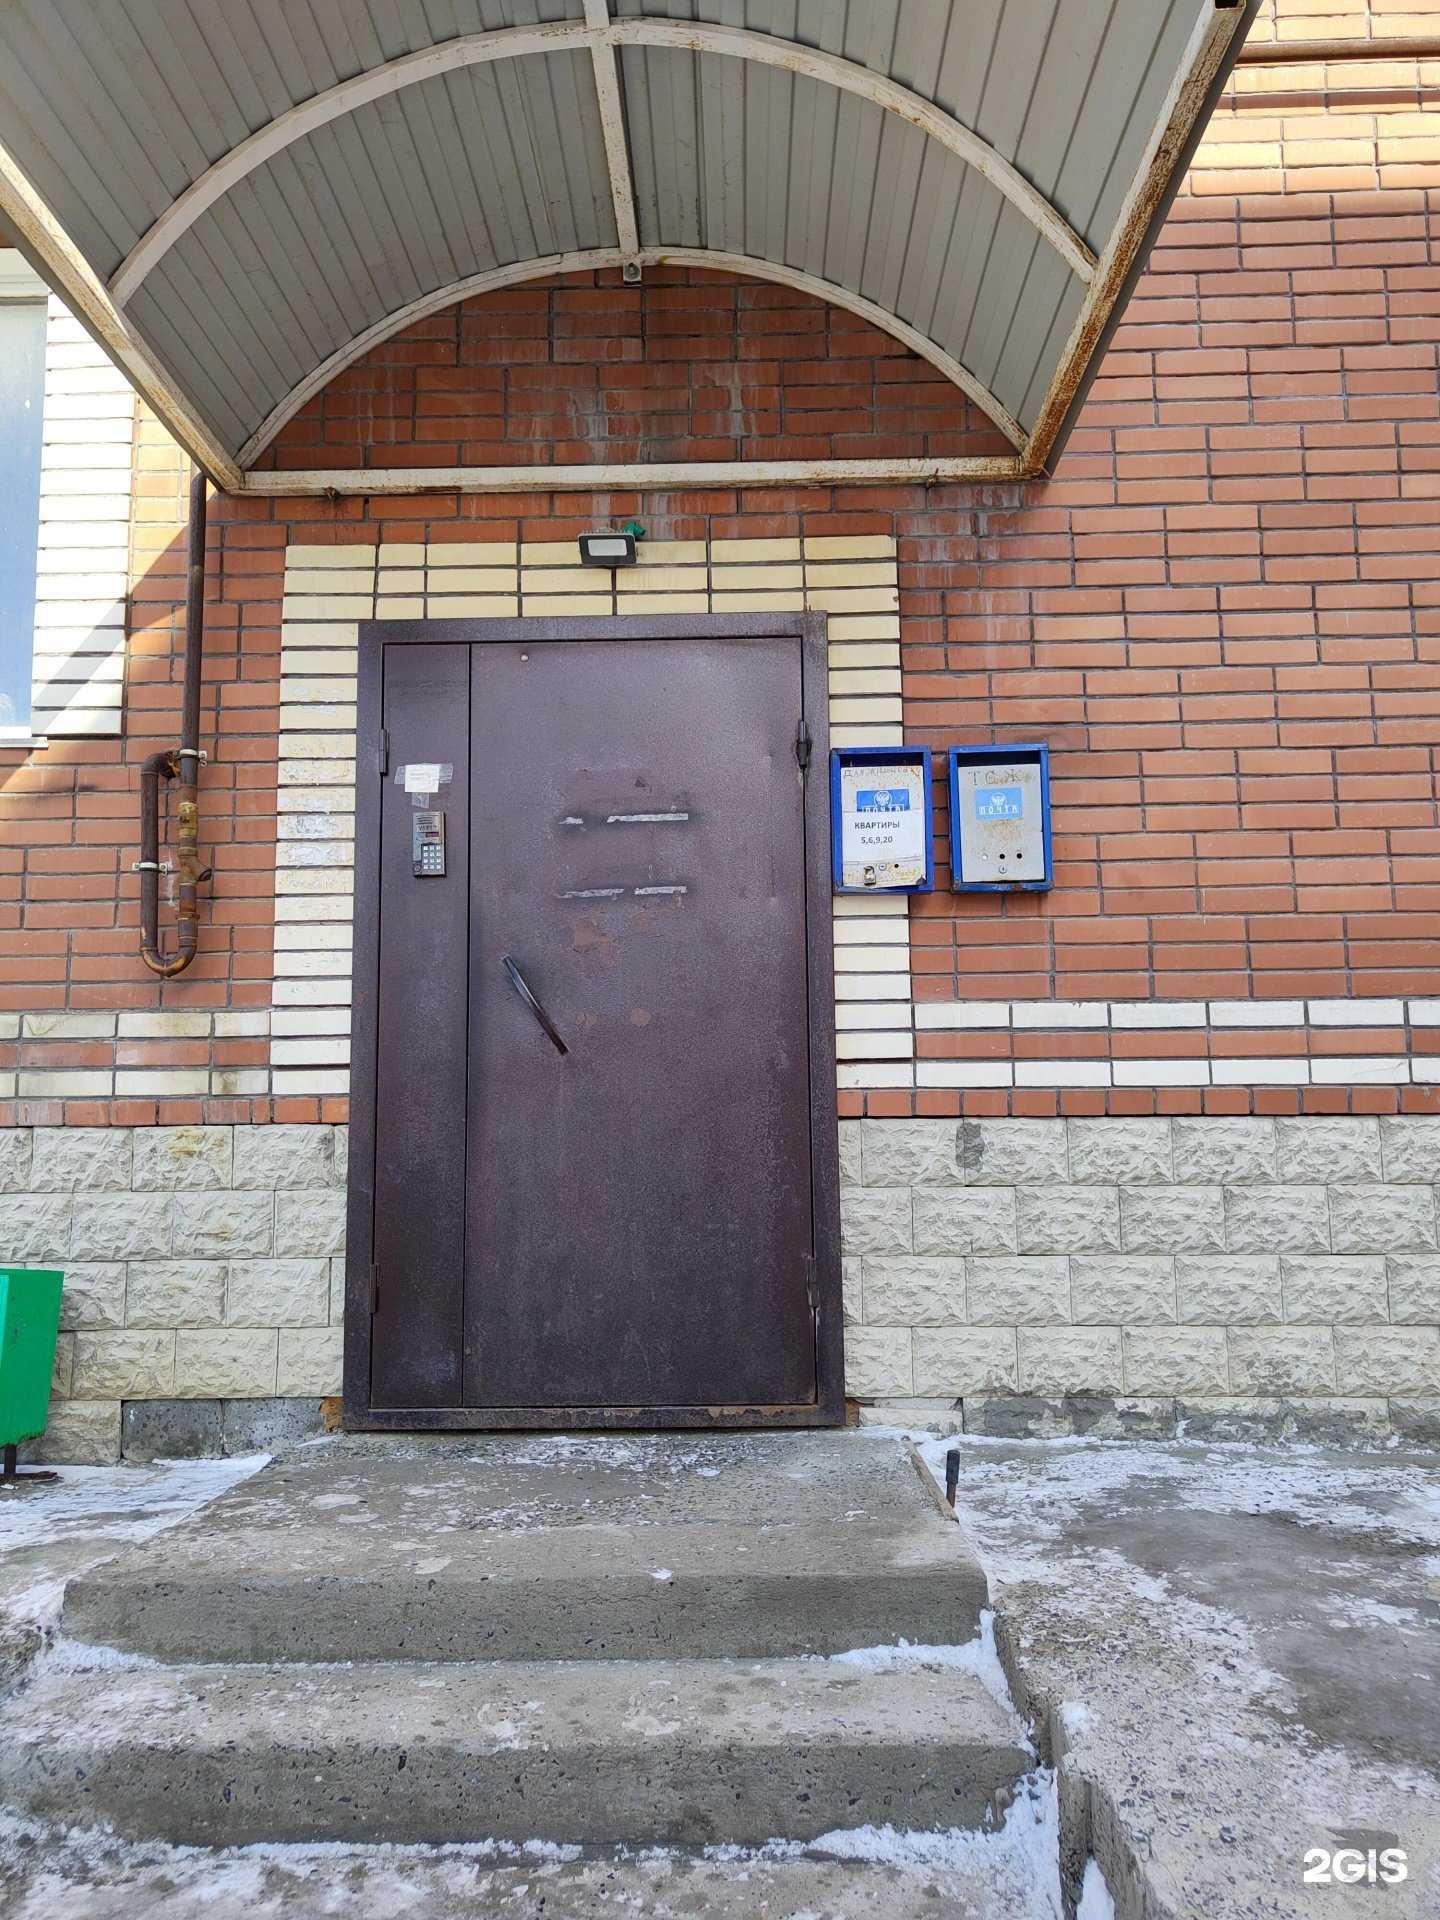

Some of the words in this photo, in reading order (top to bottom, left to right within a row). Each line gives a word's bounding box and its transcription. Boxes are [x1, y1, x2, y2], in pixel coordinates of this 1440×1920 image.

[978, 803, 1018, 815] ПОЧТА
[854, 821, 900, 830] КВАРТИРЫ
[860, 836, 893, 845] 5,6,9,20
